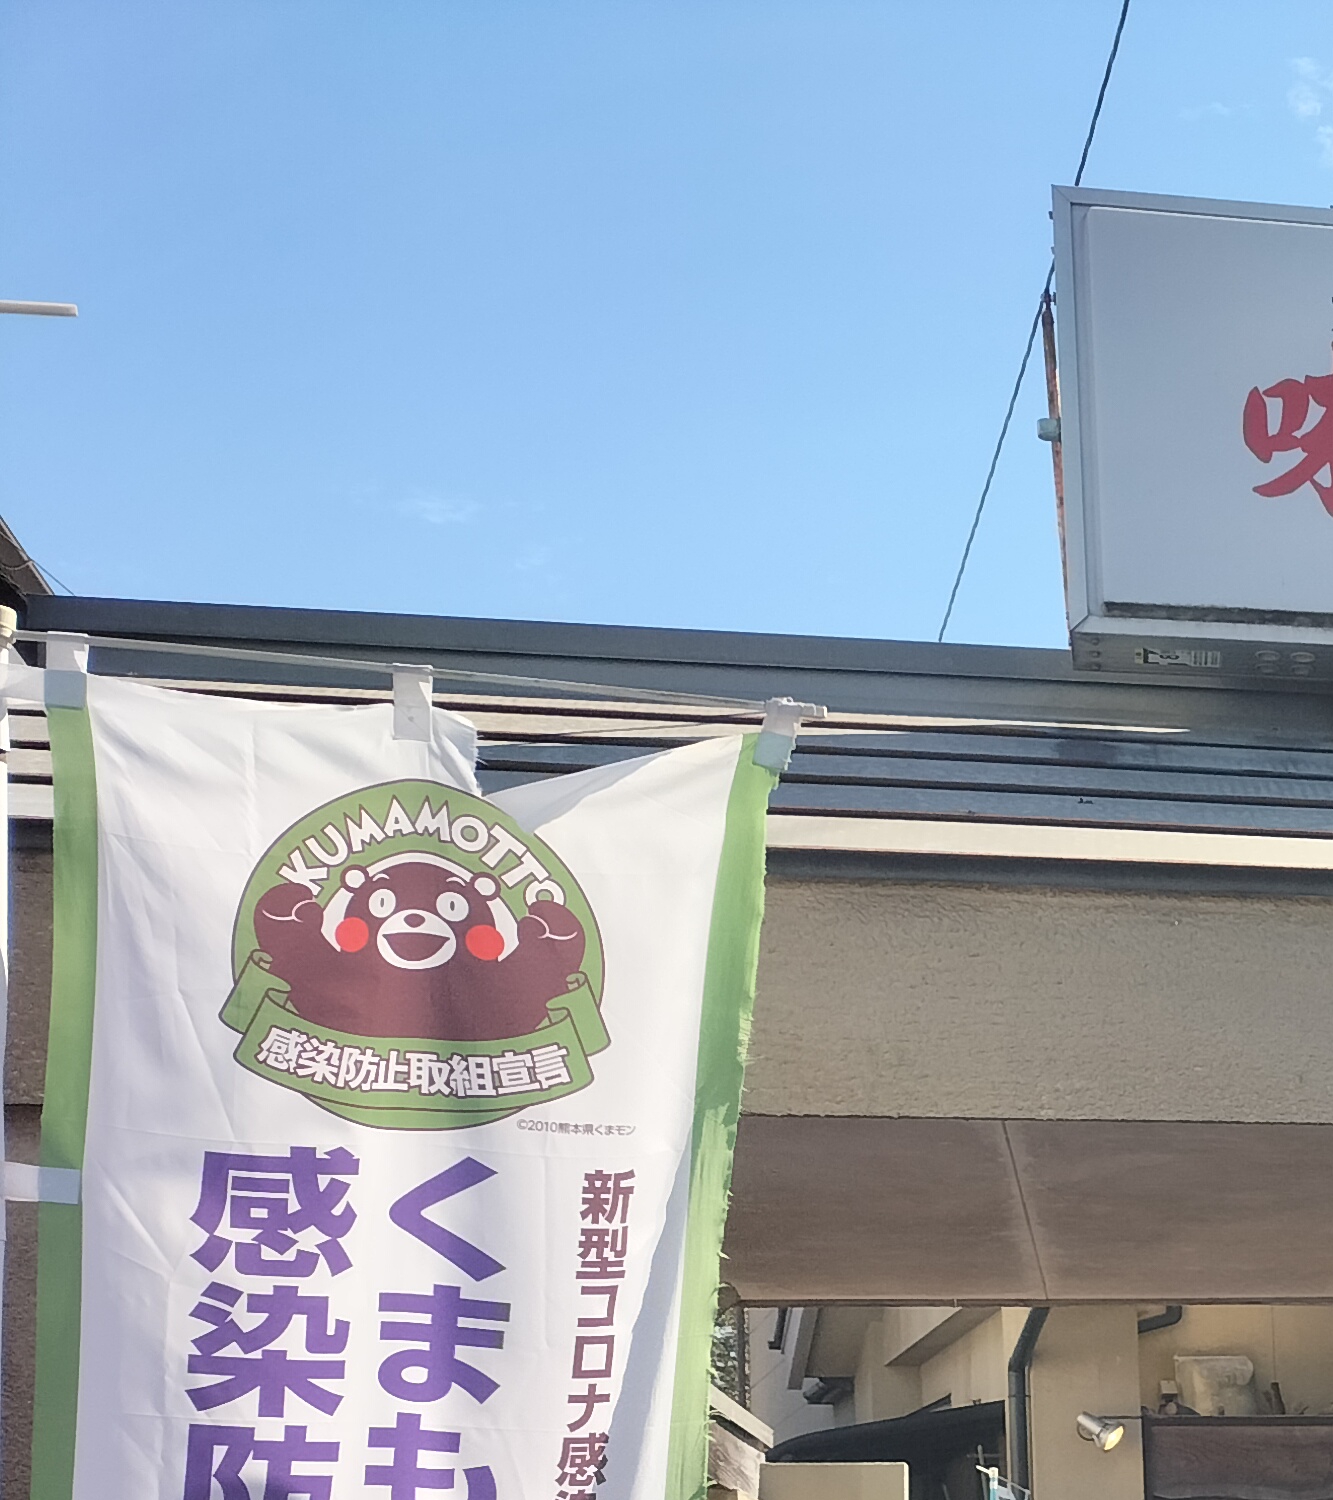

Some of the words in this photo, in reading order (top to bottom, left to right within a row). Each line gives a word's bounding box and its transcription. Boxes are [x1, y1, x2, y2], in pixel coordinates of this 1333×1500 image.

[257, 1026, 571, 1096] 感染防止取組宣言
